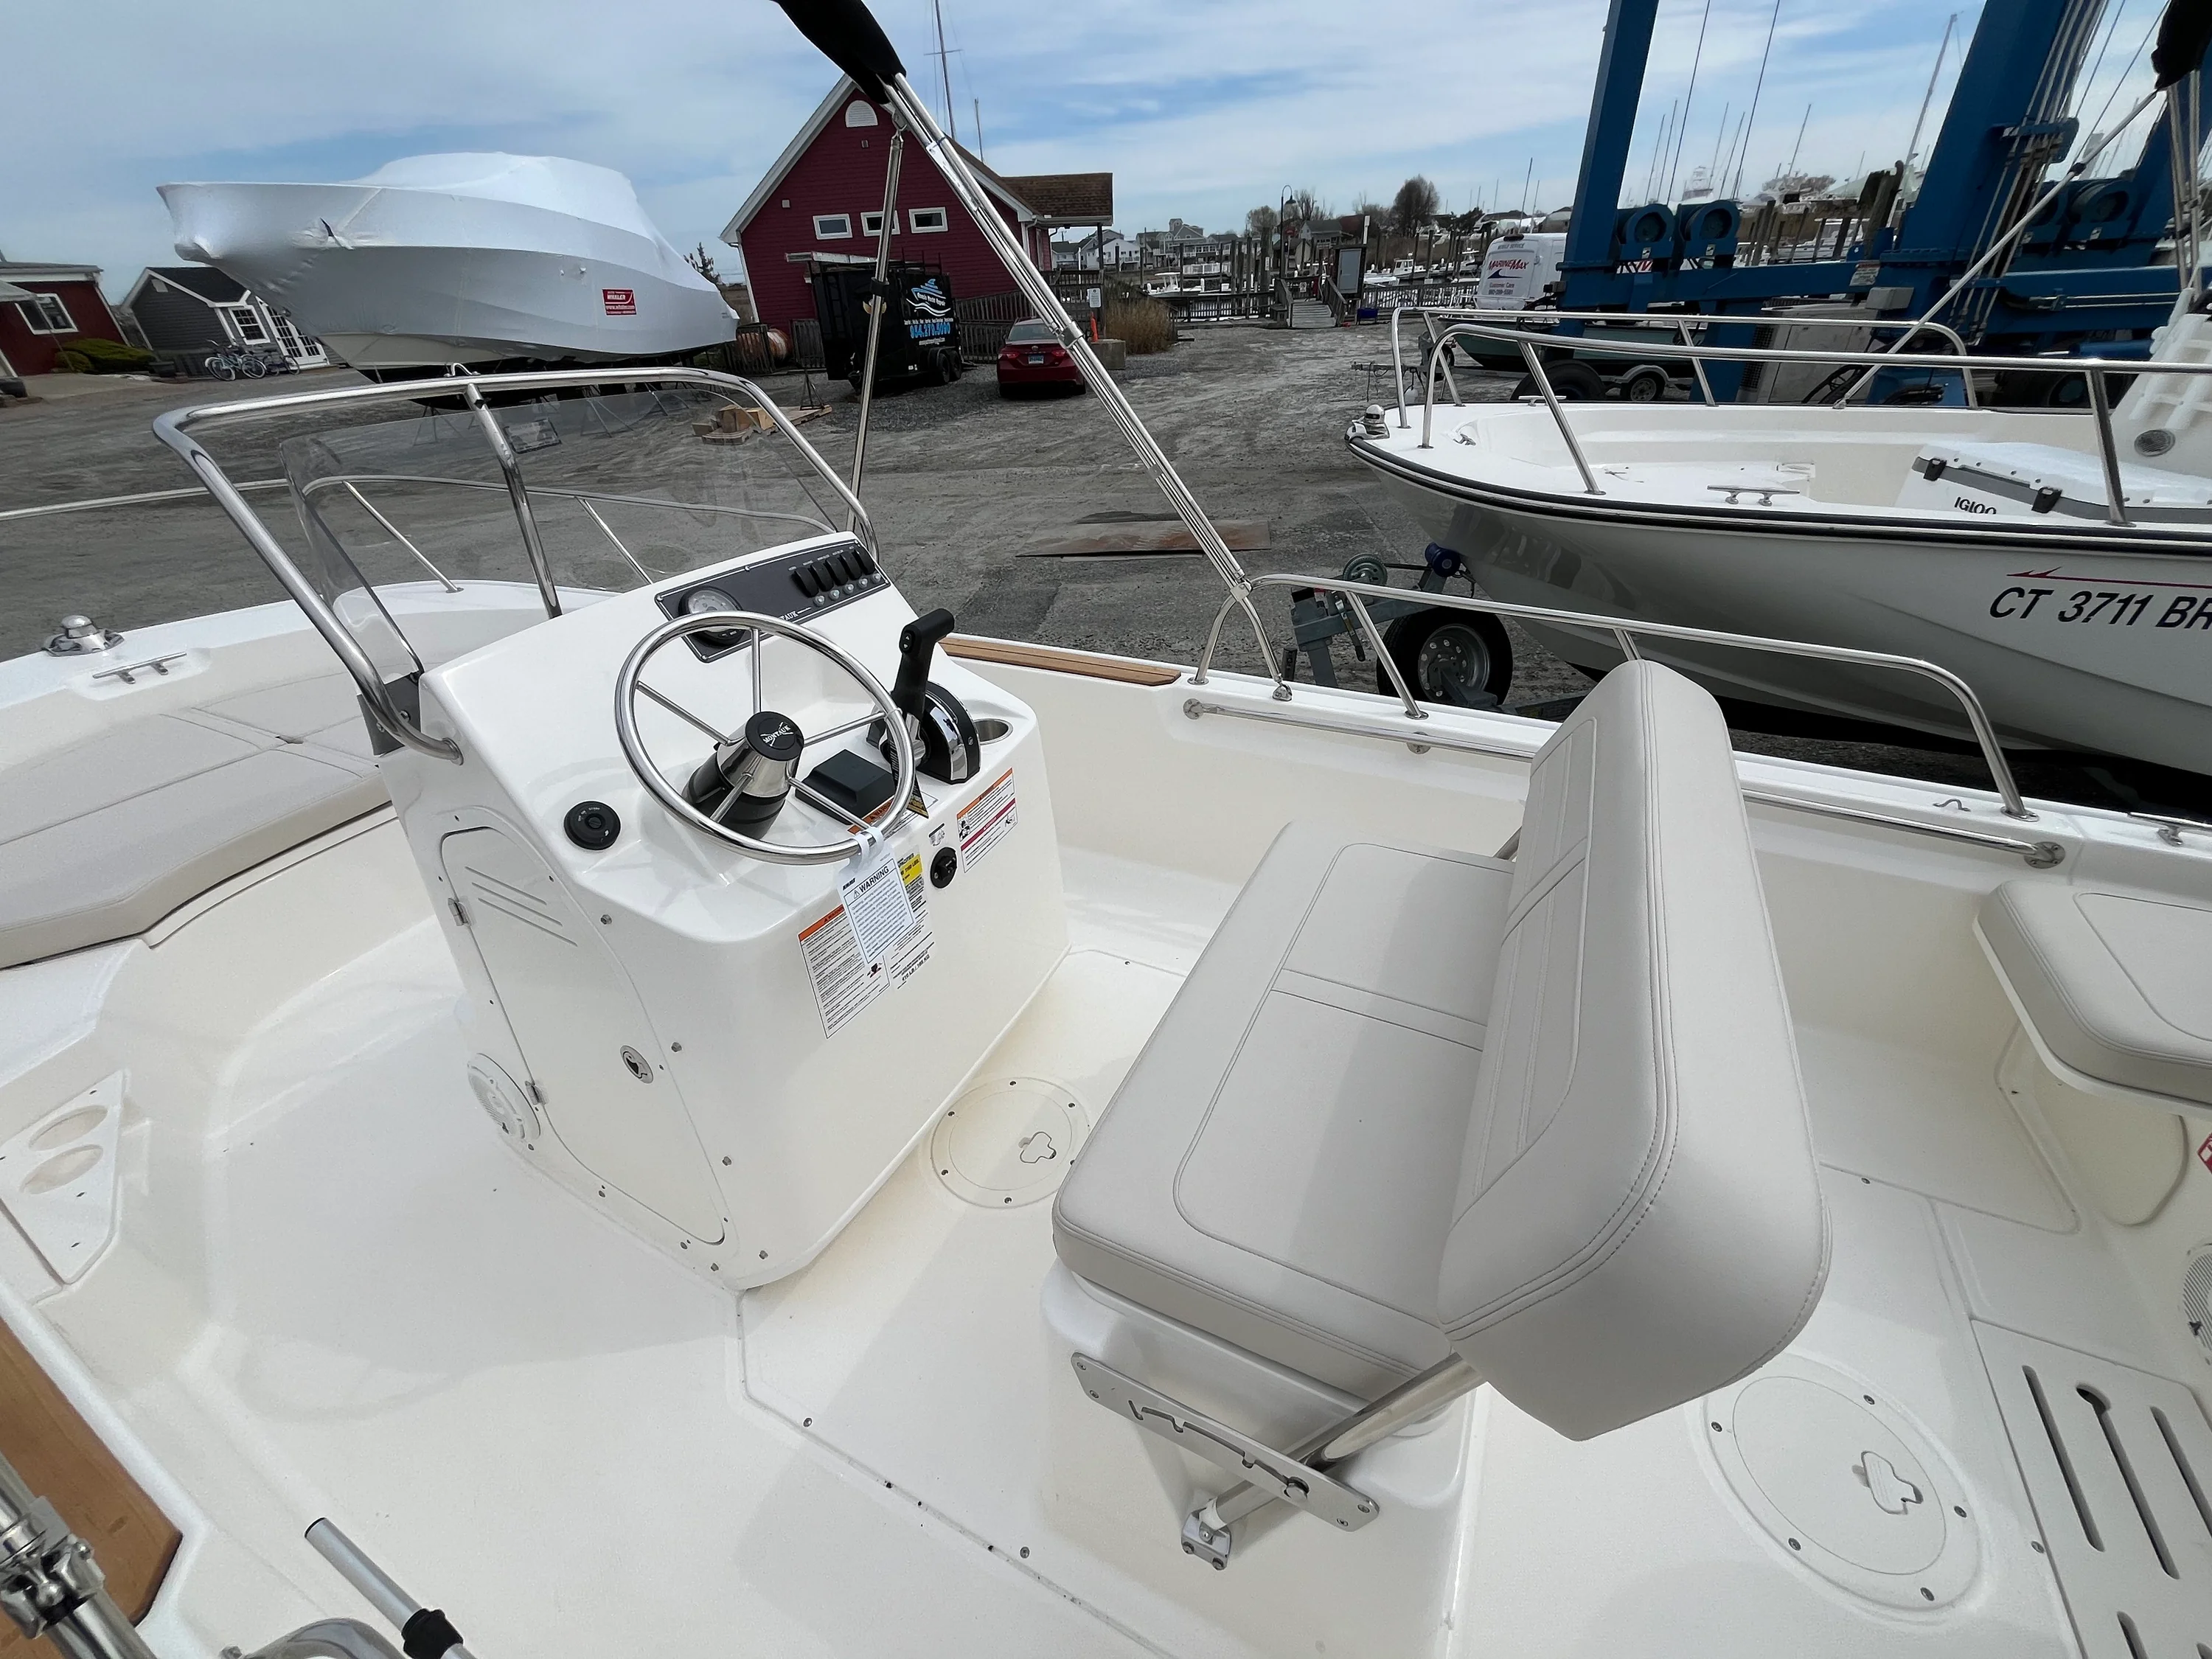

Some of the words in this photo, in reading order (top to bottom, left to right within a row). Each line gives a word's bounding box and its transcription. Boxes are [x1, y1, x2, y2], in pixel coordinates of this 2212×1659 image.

[1954, 496, 1997, 515] IGLOO
[1989, 587, 2055, 619] CT
[2058, 591, 2154, 626] 3711
[762, 725, 791, 743] MONTAUK
[859, 866, 889, 893] WARNING
